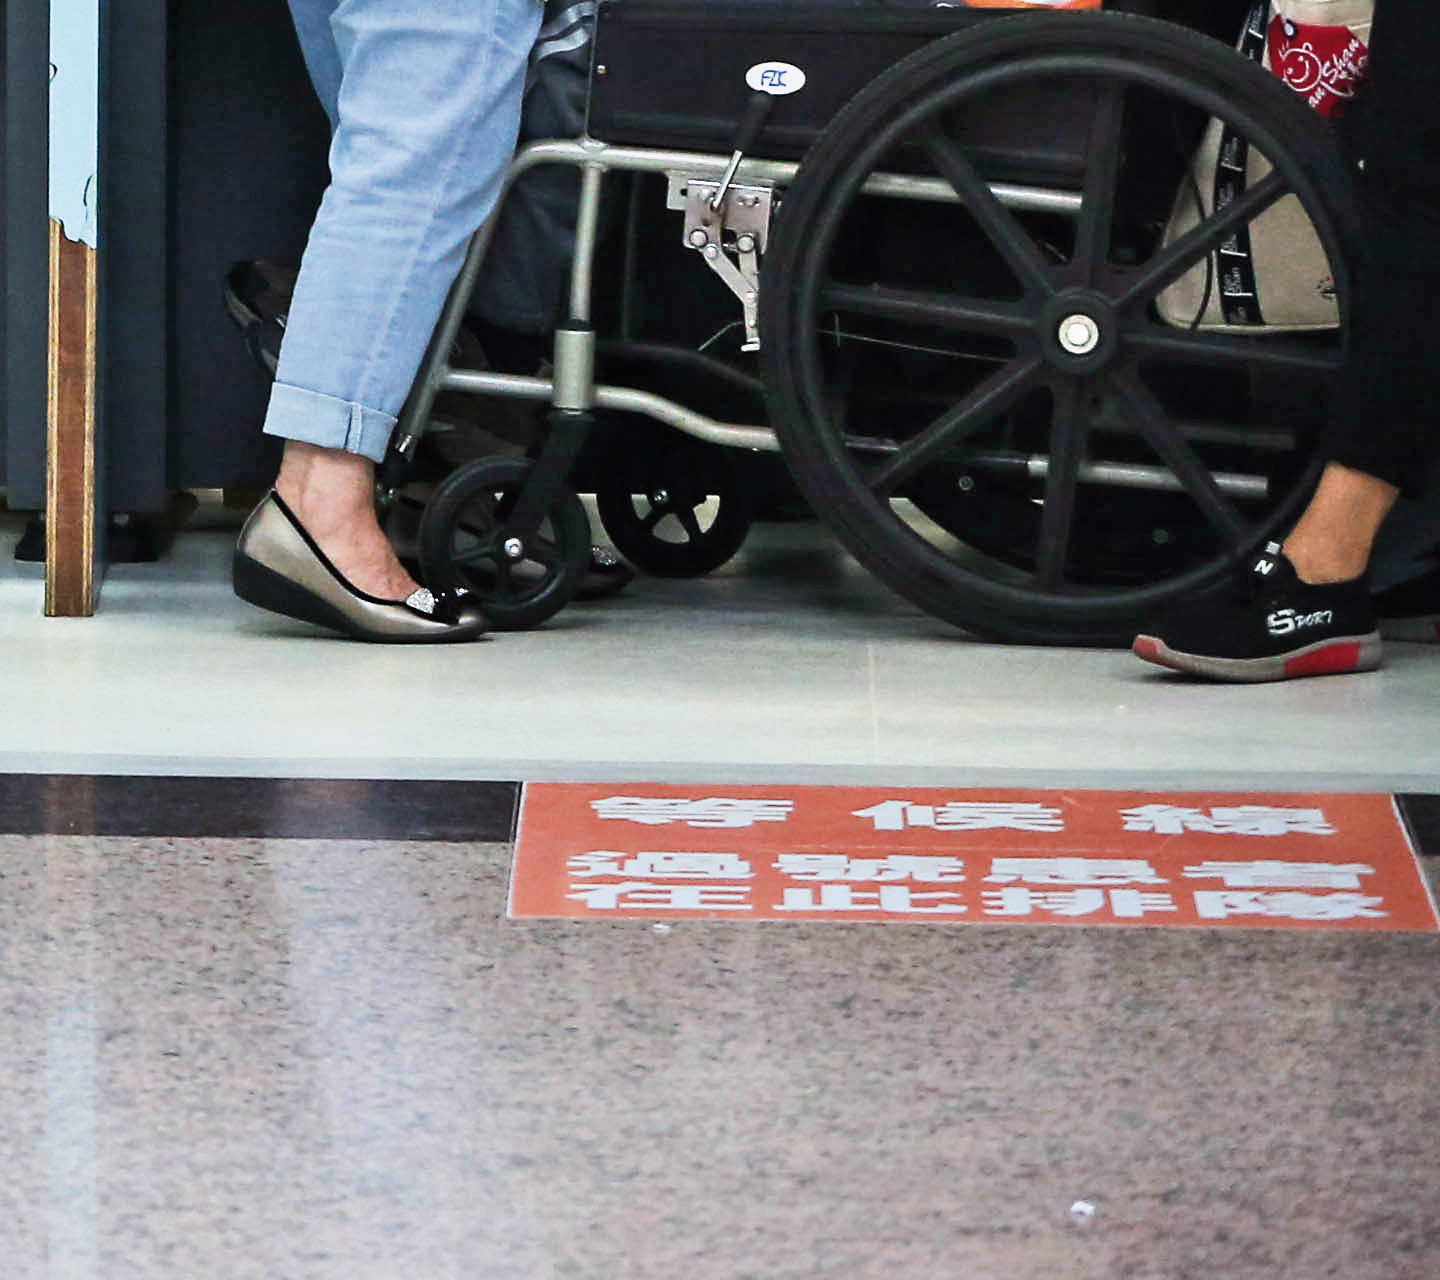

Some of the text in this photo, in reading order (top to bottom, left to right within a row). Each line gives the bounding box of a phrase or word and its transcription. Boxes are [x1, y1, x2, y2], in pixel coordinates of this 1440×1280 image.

[566, 848, 1376, 890] 過號患者
[564, 882, 1390, 923] 在此排隊
